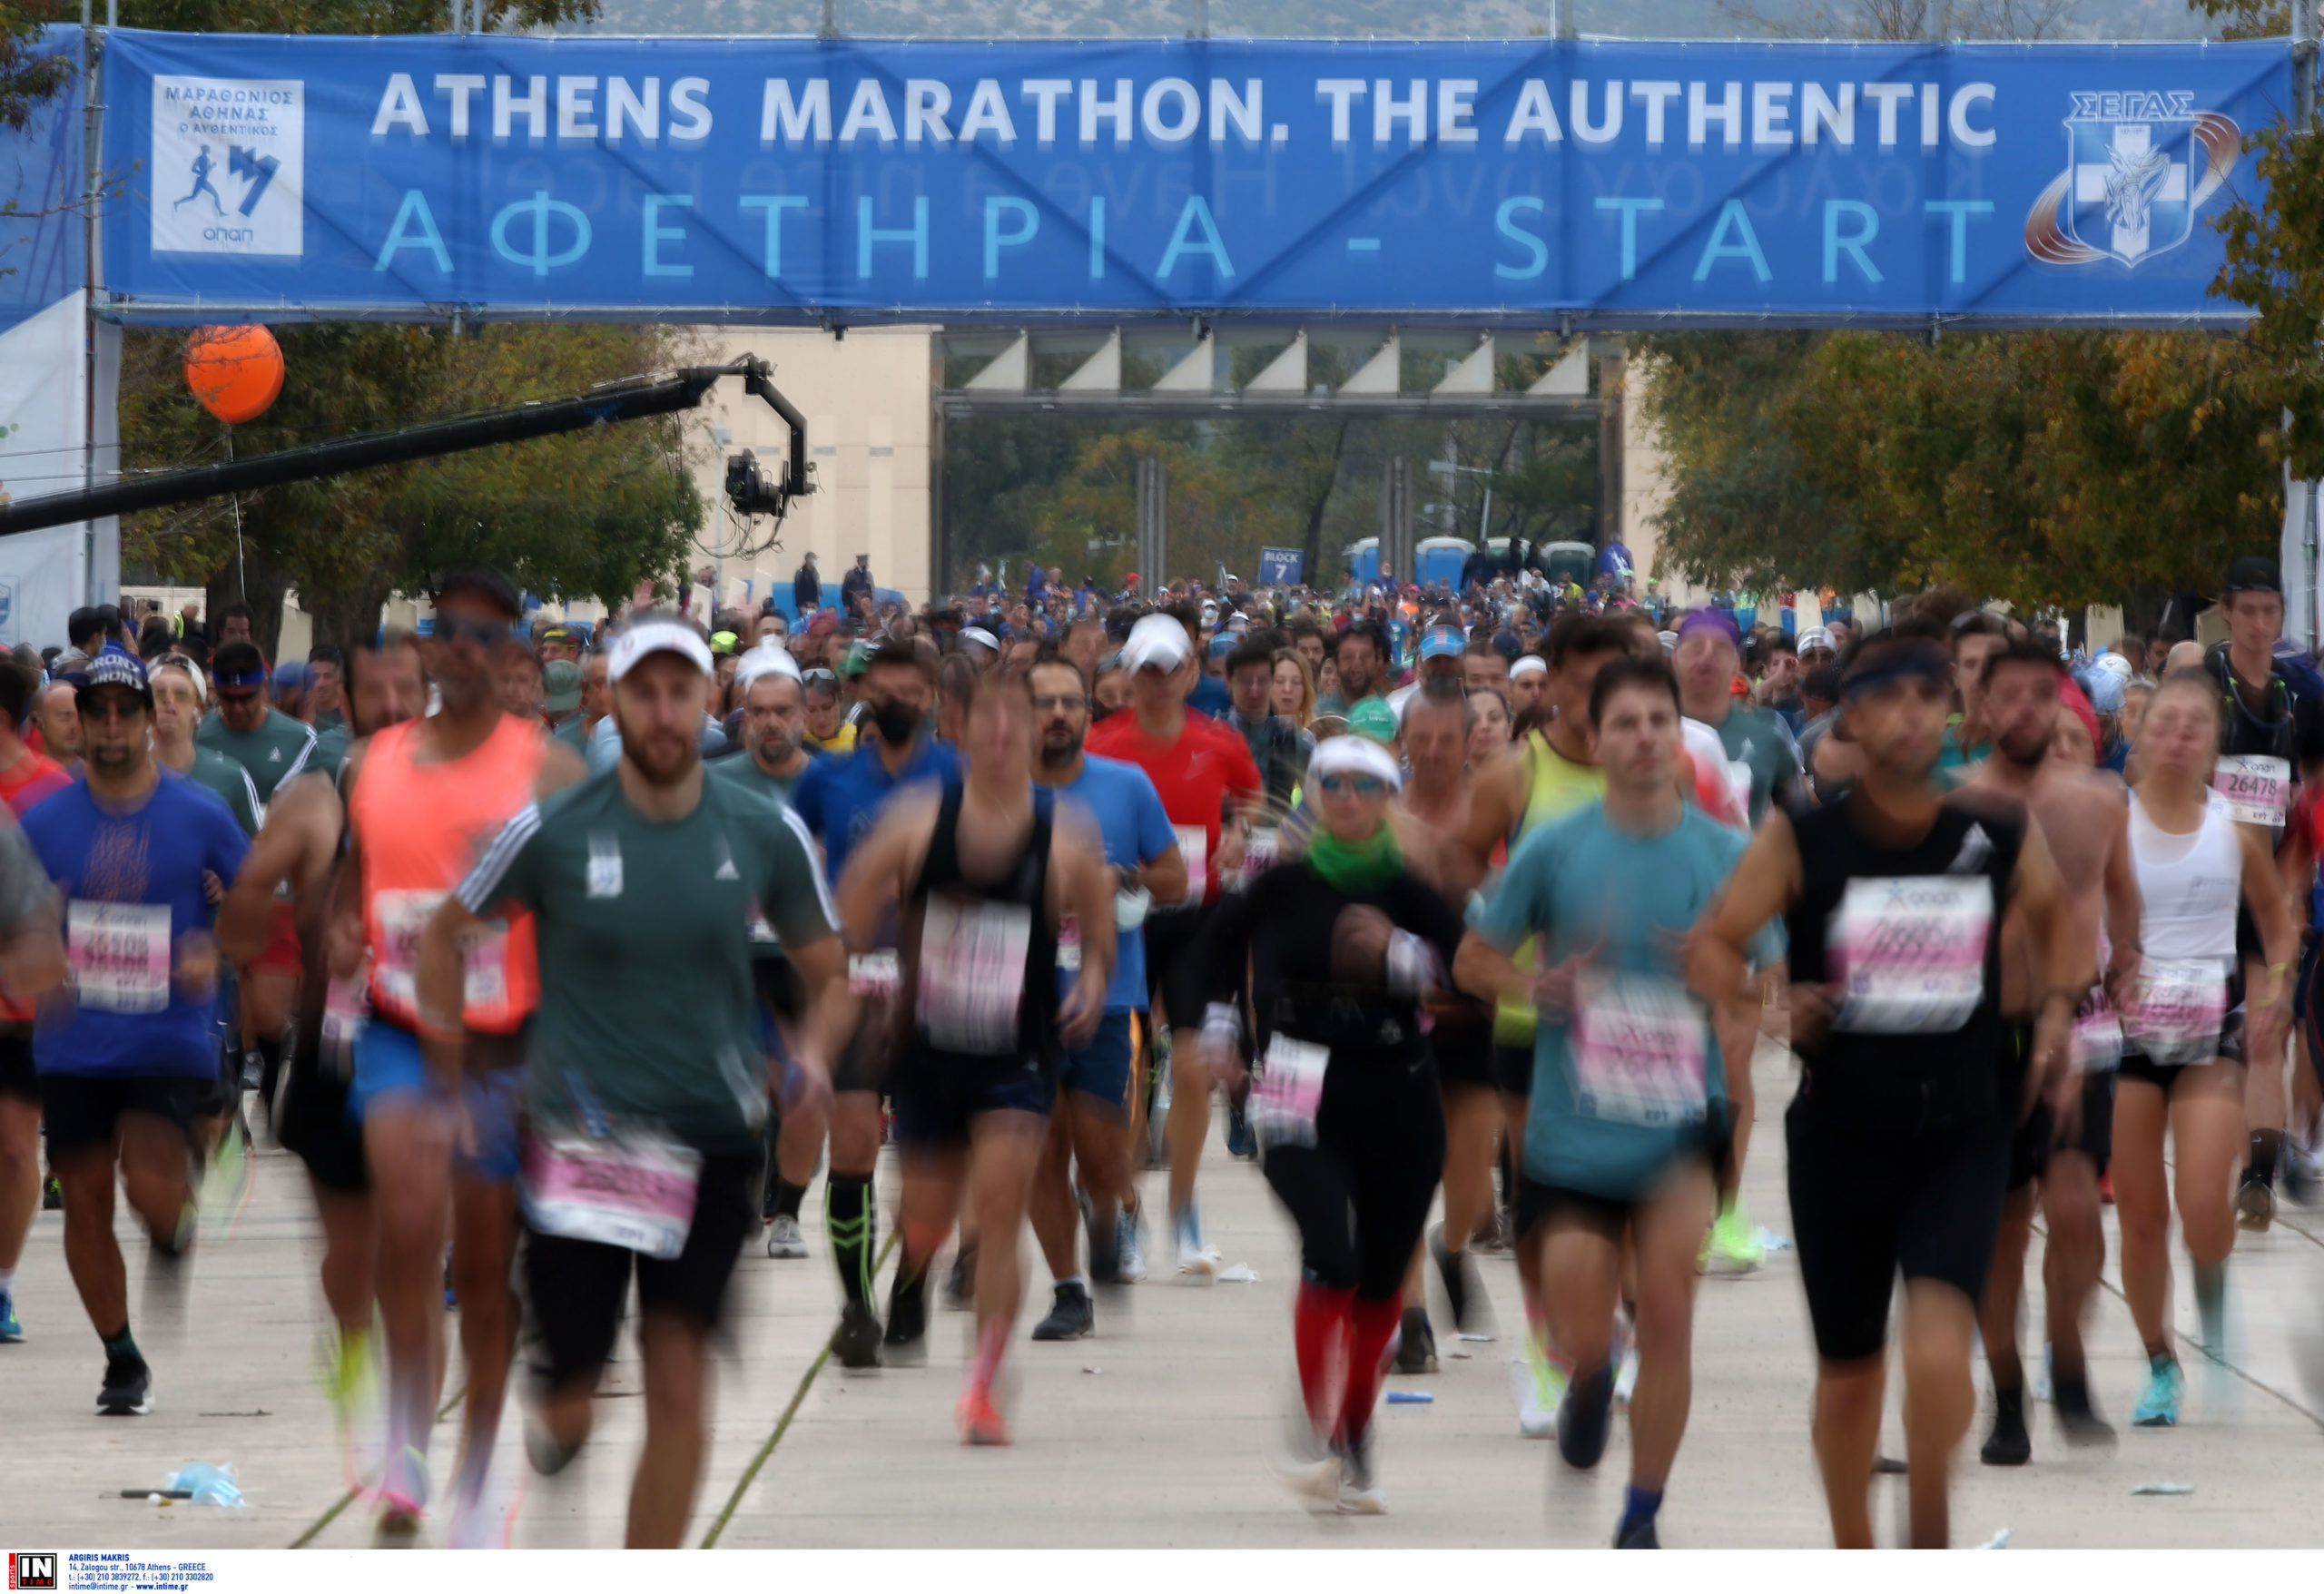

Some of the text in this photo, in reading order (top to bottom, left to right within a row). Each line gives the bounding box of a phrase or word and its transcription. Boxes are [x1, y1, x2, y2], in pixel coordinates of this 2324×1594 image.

[165, 86, 294, 105] ΜΑΡΑΘΩΝΙΟΣ
[190, 104, 270, 122] ΑΘΗΝΑΣ
[372, 74, 1997, 146] ATHENS MARATHON. THE AUTHENTIC
[2069, 92, 2194, 121] ΣΕΓΑΣ
[193, 123, 279, 136] ΑΥΘΕΝΤΙΚΟΣ
[375, 189, 1236, 279] ΑΦΕΤΗΡΙΑ
[1494, 196, 1995, 283] START
[1264, 551, 1299, 563] BLOCK
[1275, 564, 1287, 580] 7
[2229, 773, 2277, 797] 26478
